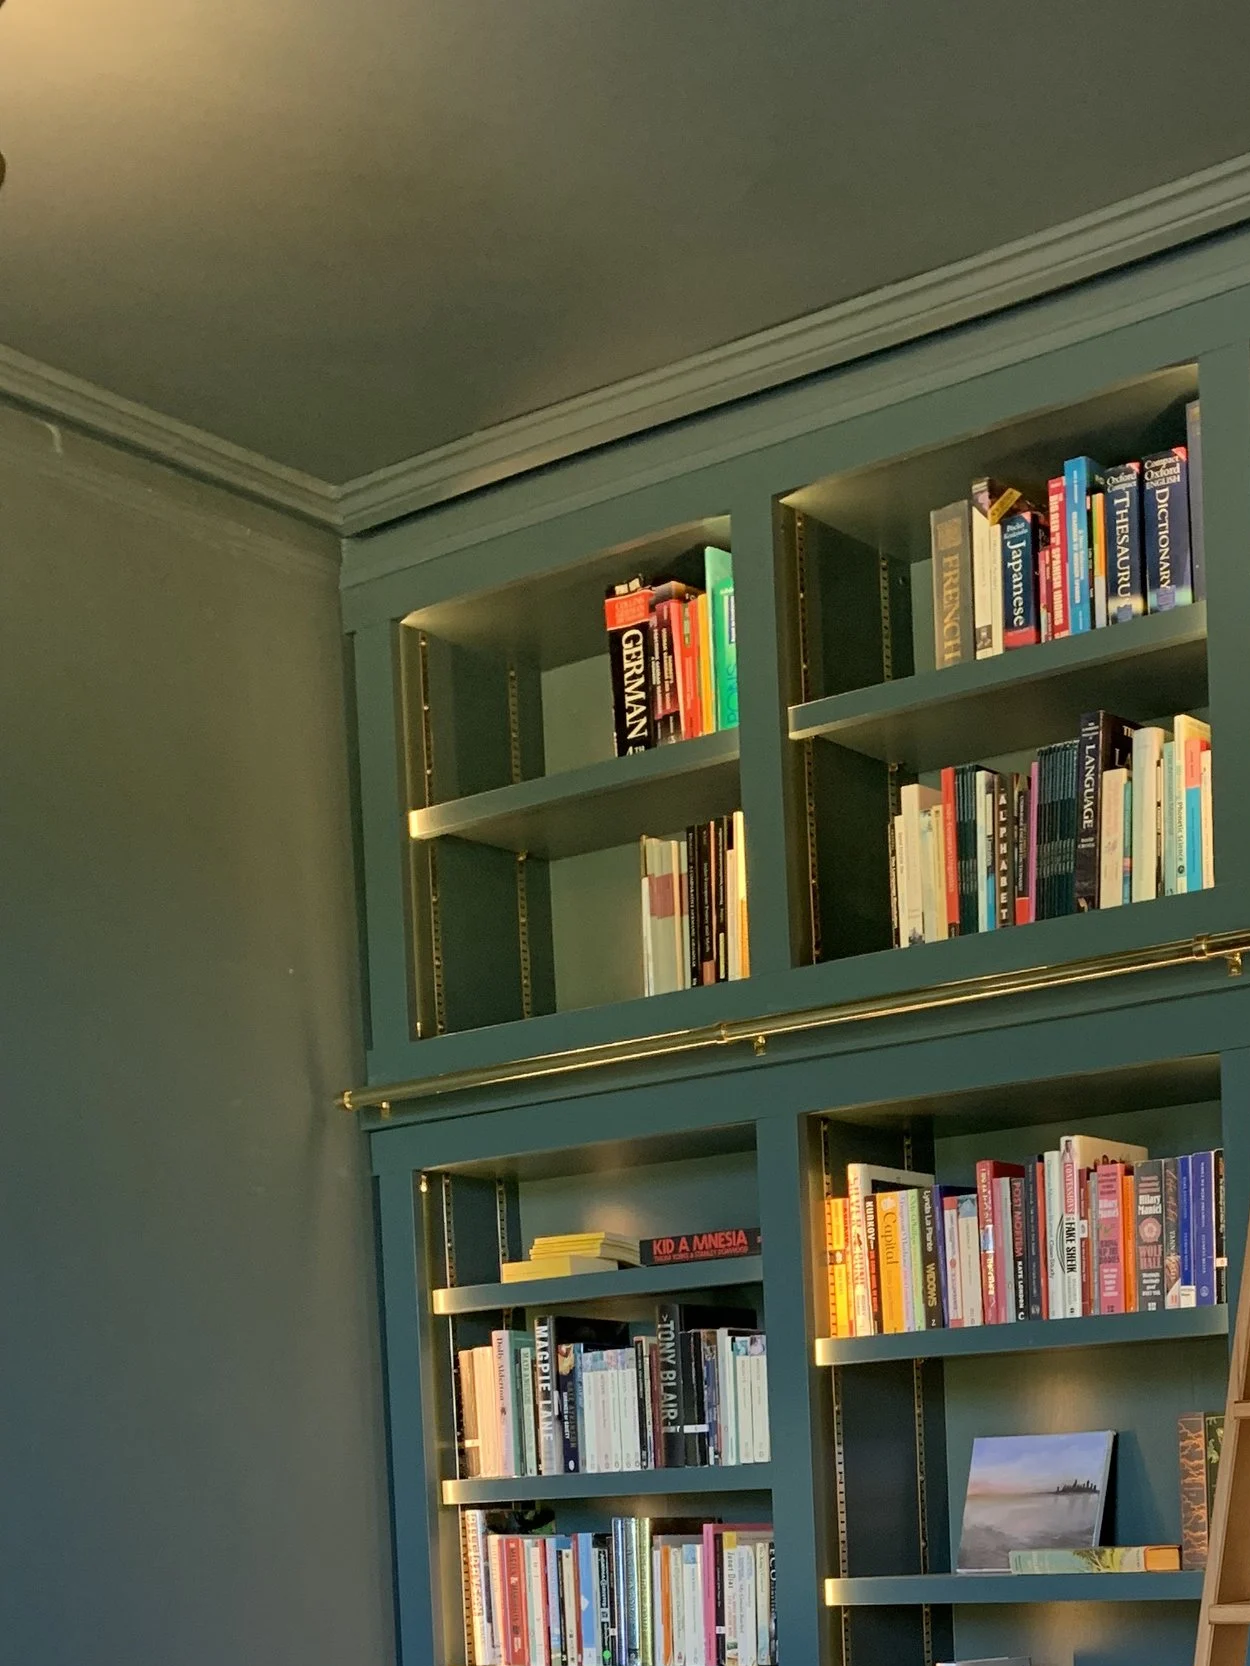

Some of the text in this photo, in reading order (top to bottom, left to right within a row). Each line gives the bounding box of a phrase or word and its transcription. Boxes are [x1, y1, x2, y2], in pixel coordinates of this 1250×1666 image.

[1145, 466, 1180, 482] Oxford
[1155, 487, 1171, 591] DICTIONARY
[943, 553, 962, 662] FRENCH
[1007, 540, 1025, 627] Japanese
[622, 629, 648, 739] GERMAN
[1082, 743, 1098, 830] LANGUAGE
[653, 1229, 748, 1256] KID A MNESIA
[866, 1201, 876, 1241] KURKOV
[881, 1212, 899, 1265] Capital
[923, 1190, 937, 1308] Lynda La Plante WIDOWS
[1065, 1222, 1077, 1274] FAKE SHEIK
[1017, 1261, 1025, 1279] KATE
[536, 1325, 554, 1441] MAGPIE LANE
[660, 1370, 678, 1421] BLAIR
